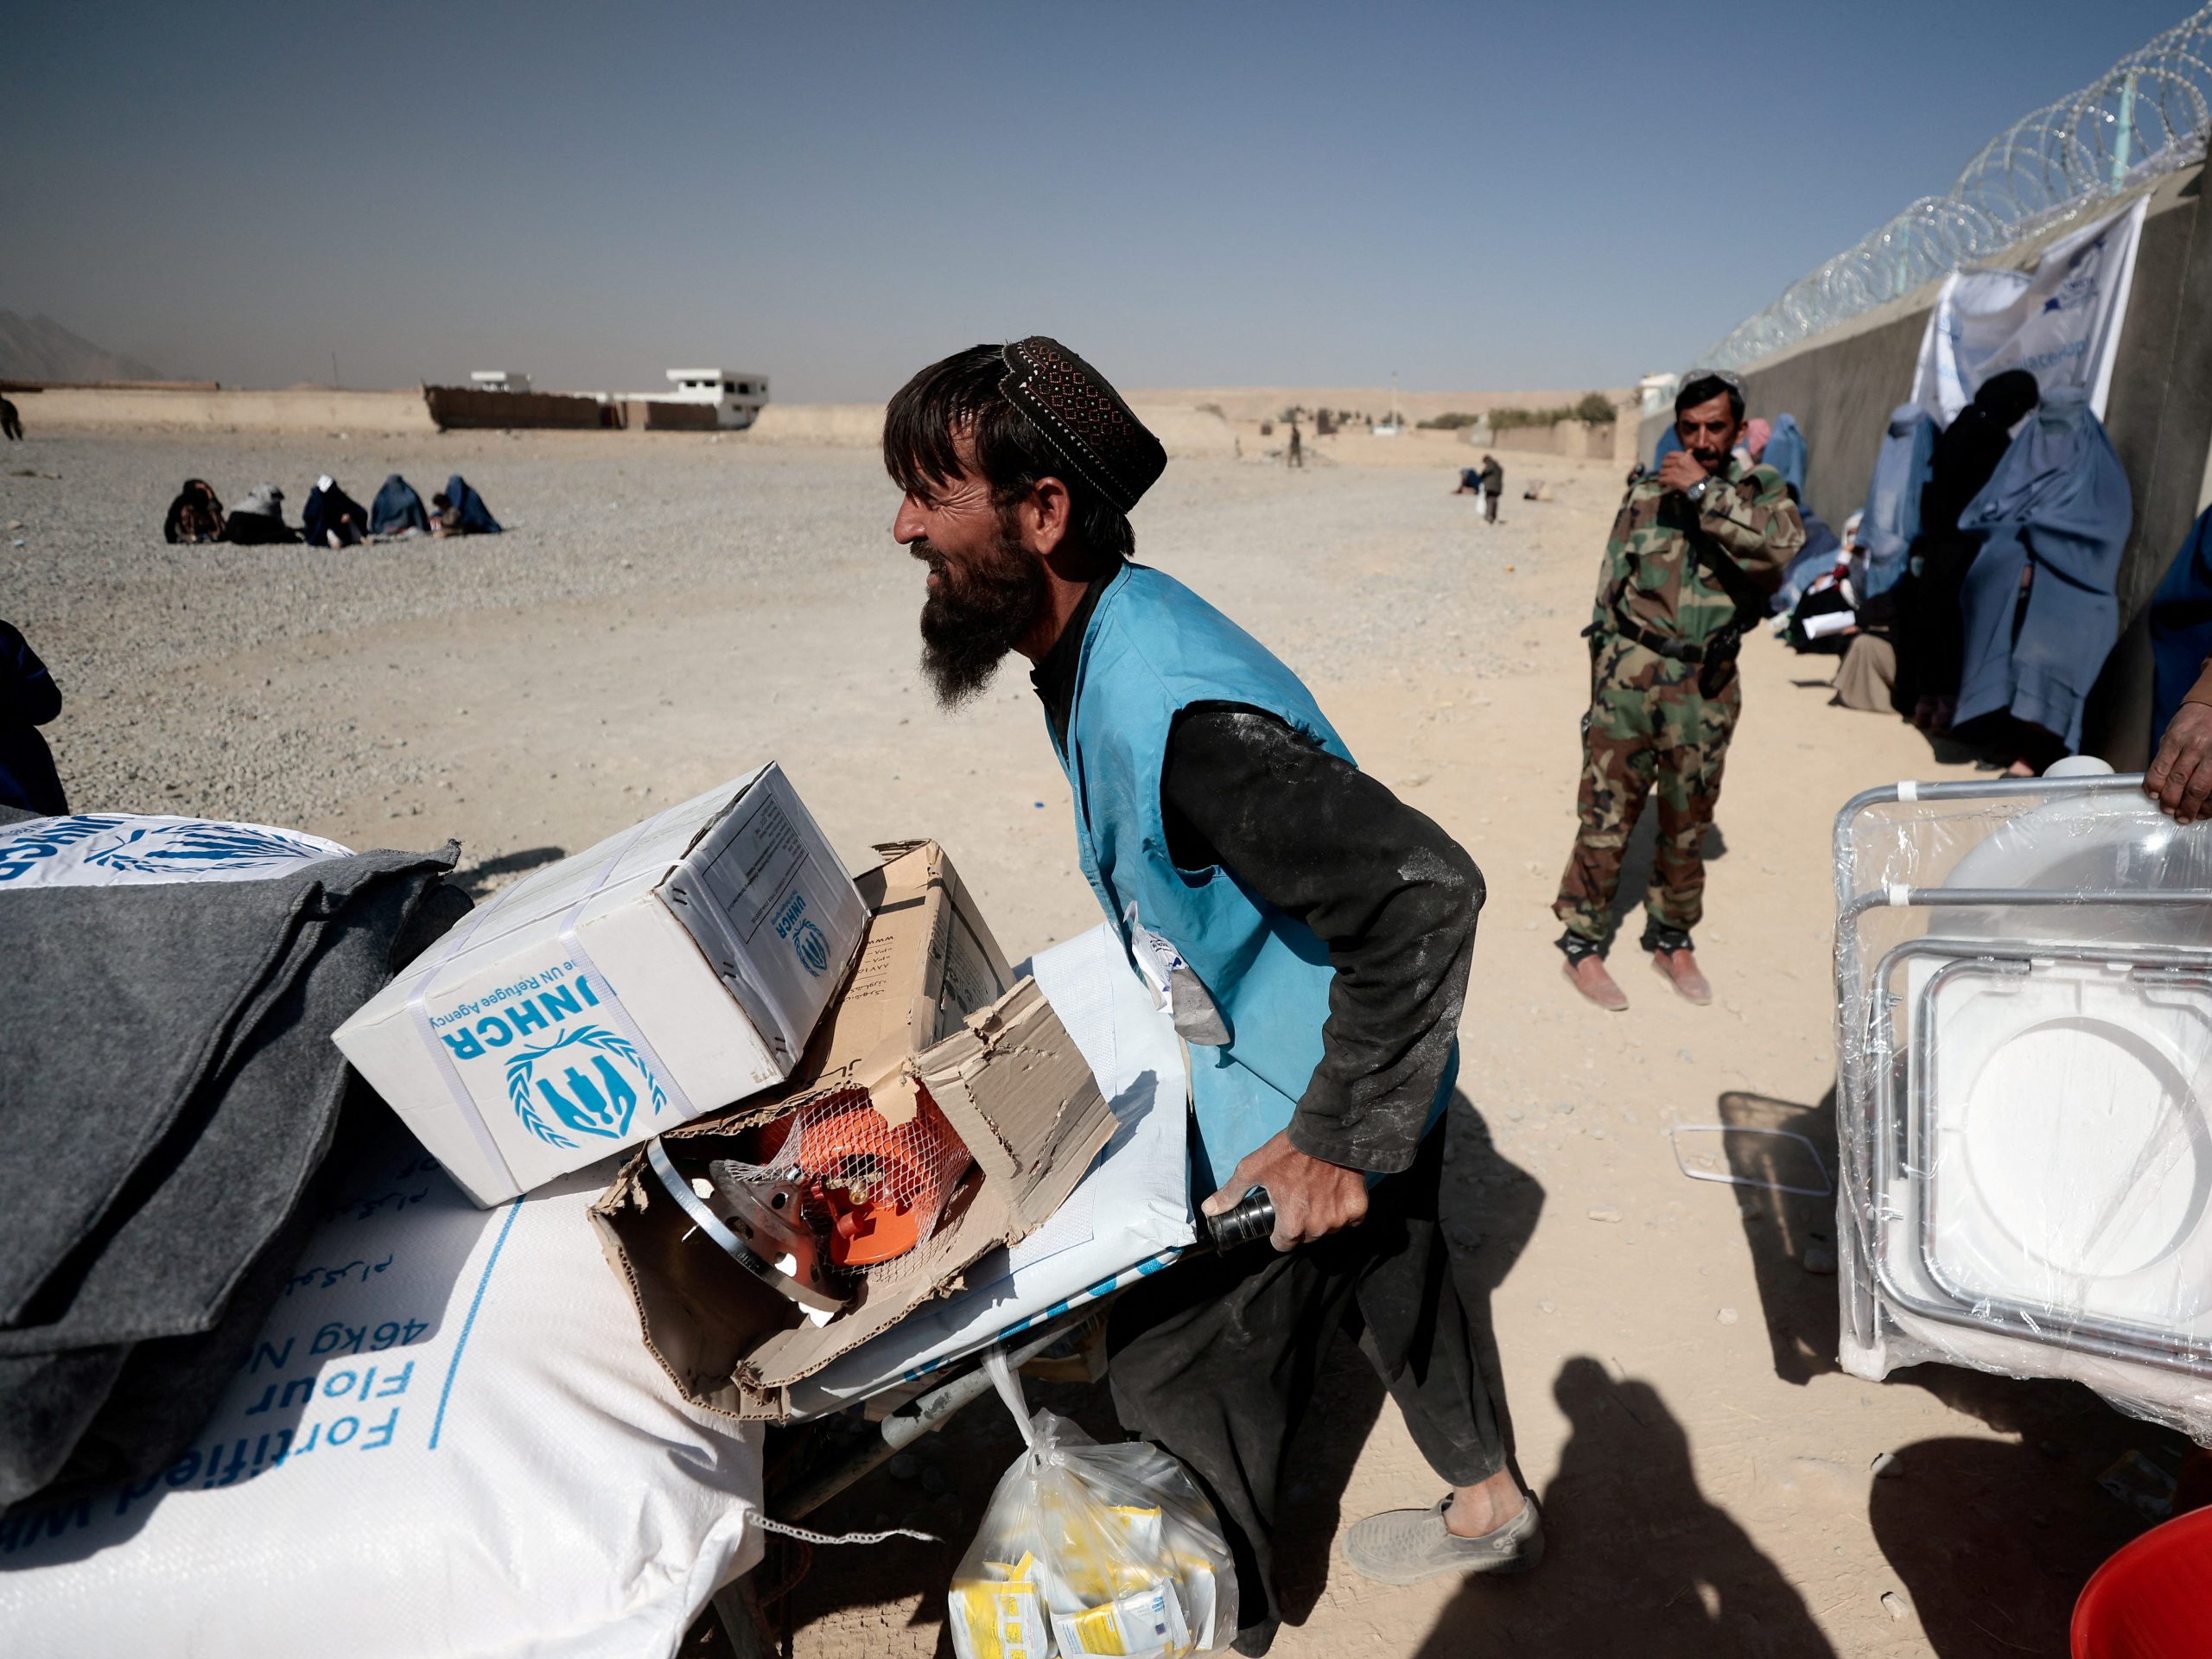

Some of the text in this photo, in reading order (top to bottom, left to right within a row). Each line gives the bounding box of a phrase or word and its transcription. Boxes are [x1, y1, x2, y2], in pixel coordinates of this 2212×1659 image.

[776, 895, 806, 939] UNHCR
[482, 976, 540, 1007] Refugee
[538, 966, 565, 985] UN
[429, 1004, 481, 1028] Agency
[309, 1317, 429, 1356] 46kg
[245, 1360, 416, 1416] Flour
[114, 1406, 401, 1516] Fortified
